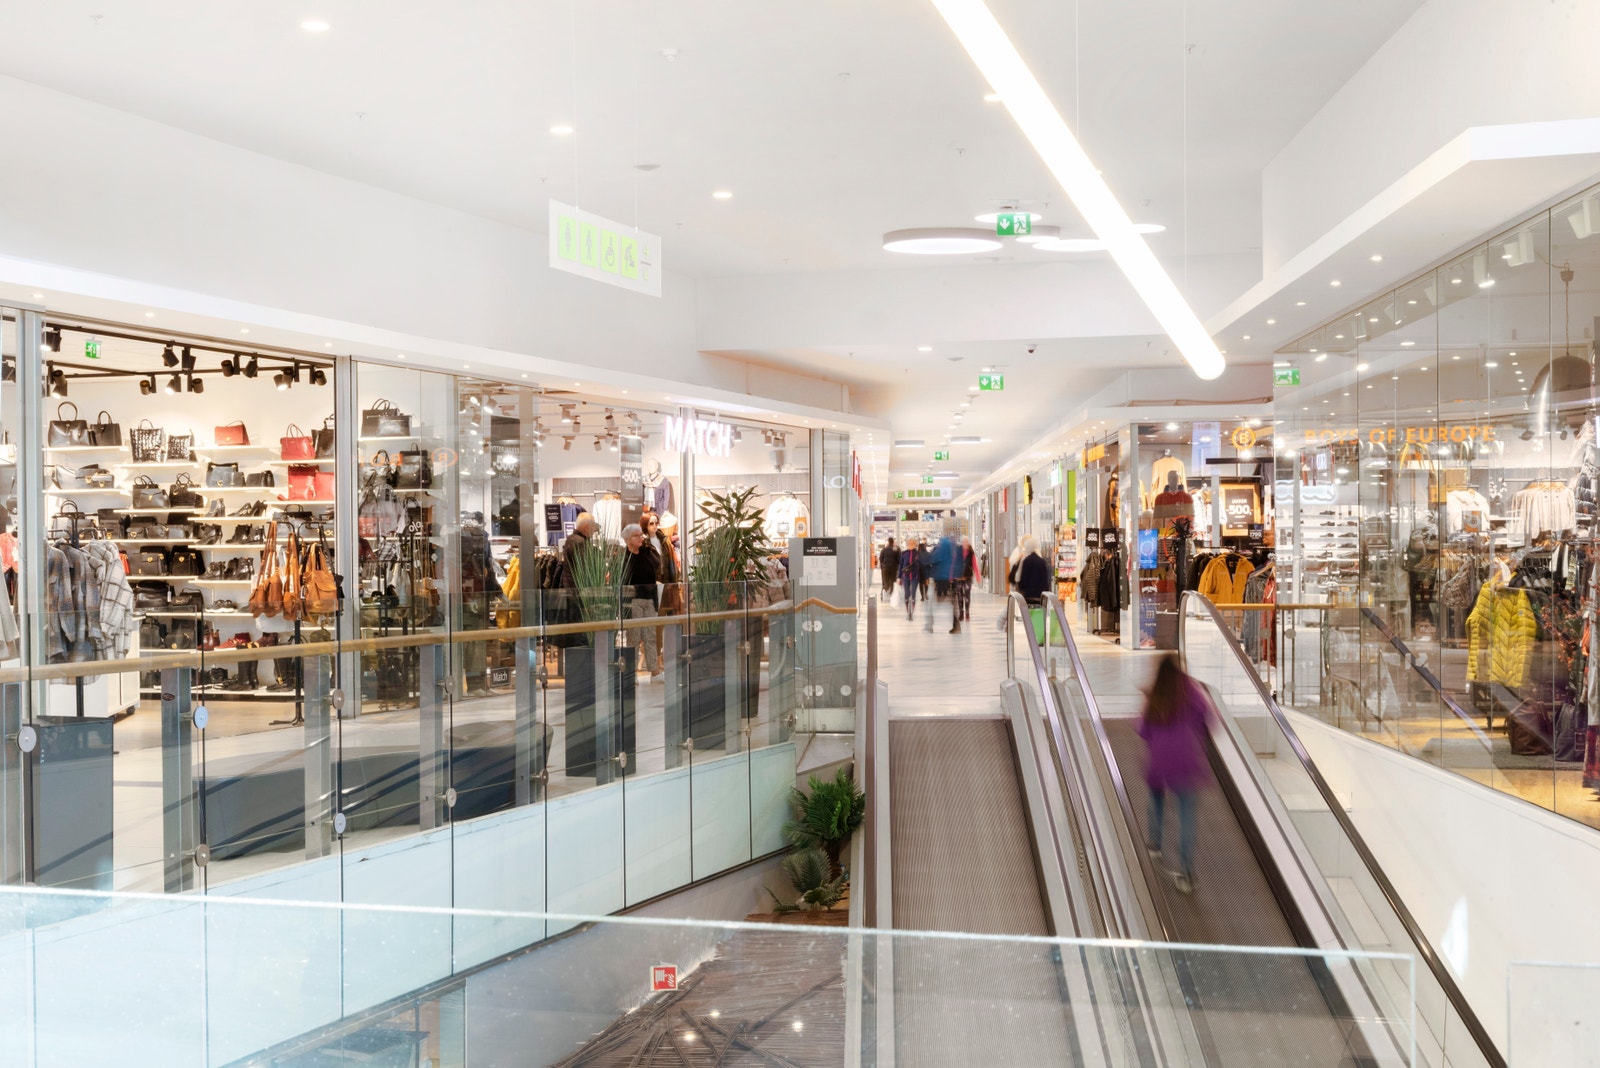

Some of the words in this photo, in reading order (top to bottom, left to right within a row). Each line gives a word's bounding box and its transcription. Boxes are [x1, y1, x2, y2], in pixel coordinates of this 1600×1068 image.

[664, 415, 731, 457] MATCH
[1304, 428, 1358, 445] BOYS
[1369, 427, 1396, 444] OF
[1405, 425, 1495, 444] EUROPE
